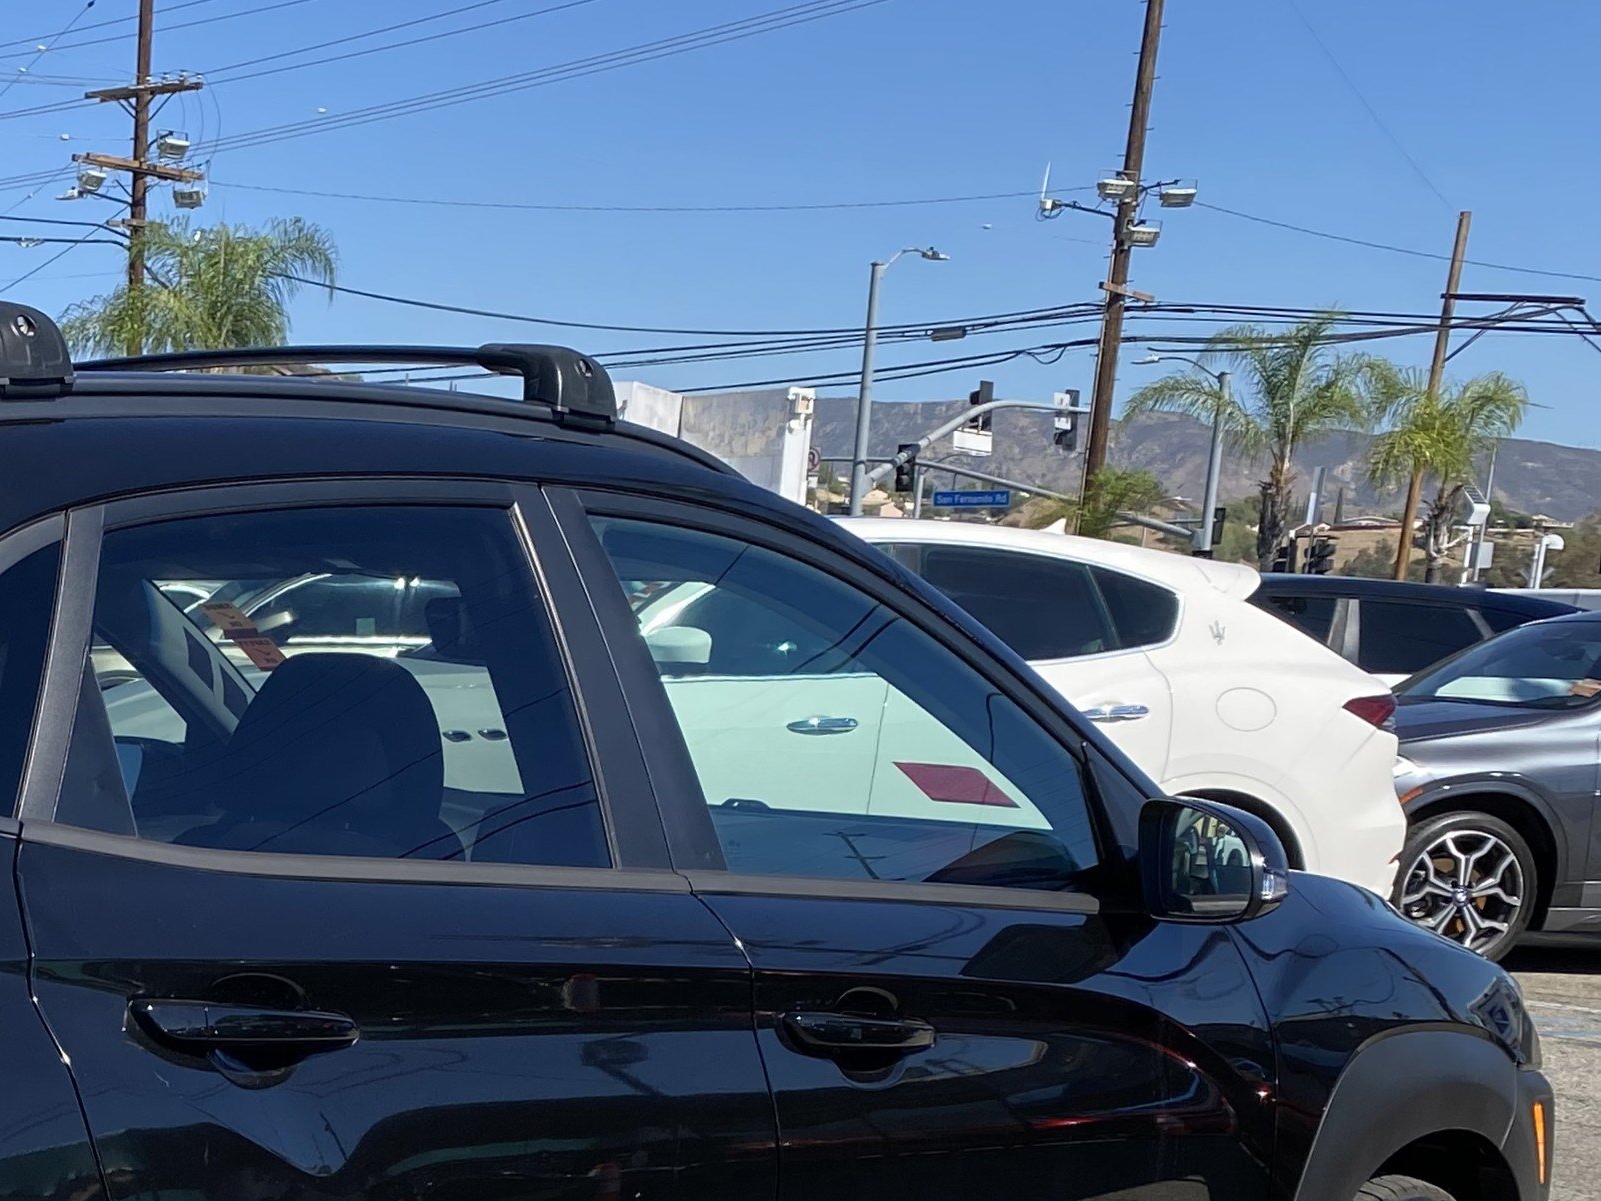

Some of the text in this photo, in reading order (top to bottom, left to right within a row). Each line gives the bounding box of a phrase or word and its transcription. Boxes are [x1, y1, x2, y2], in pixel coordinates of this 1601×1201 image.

[937, 493, 1007, 504] San Fernando Rd
